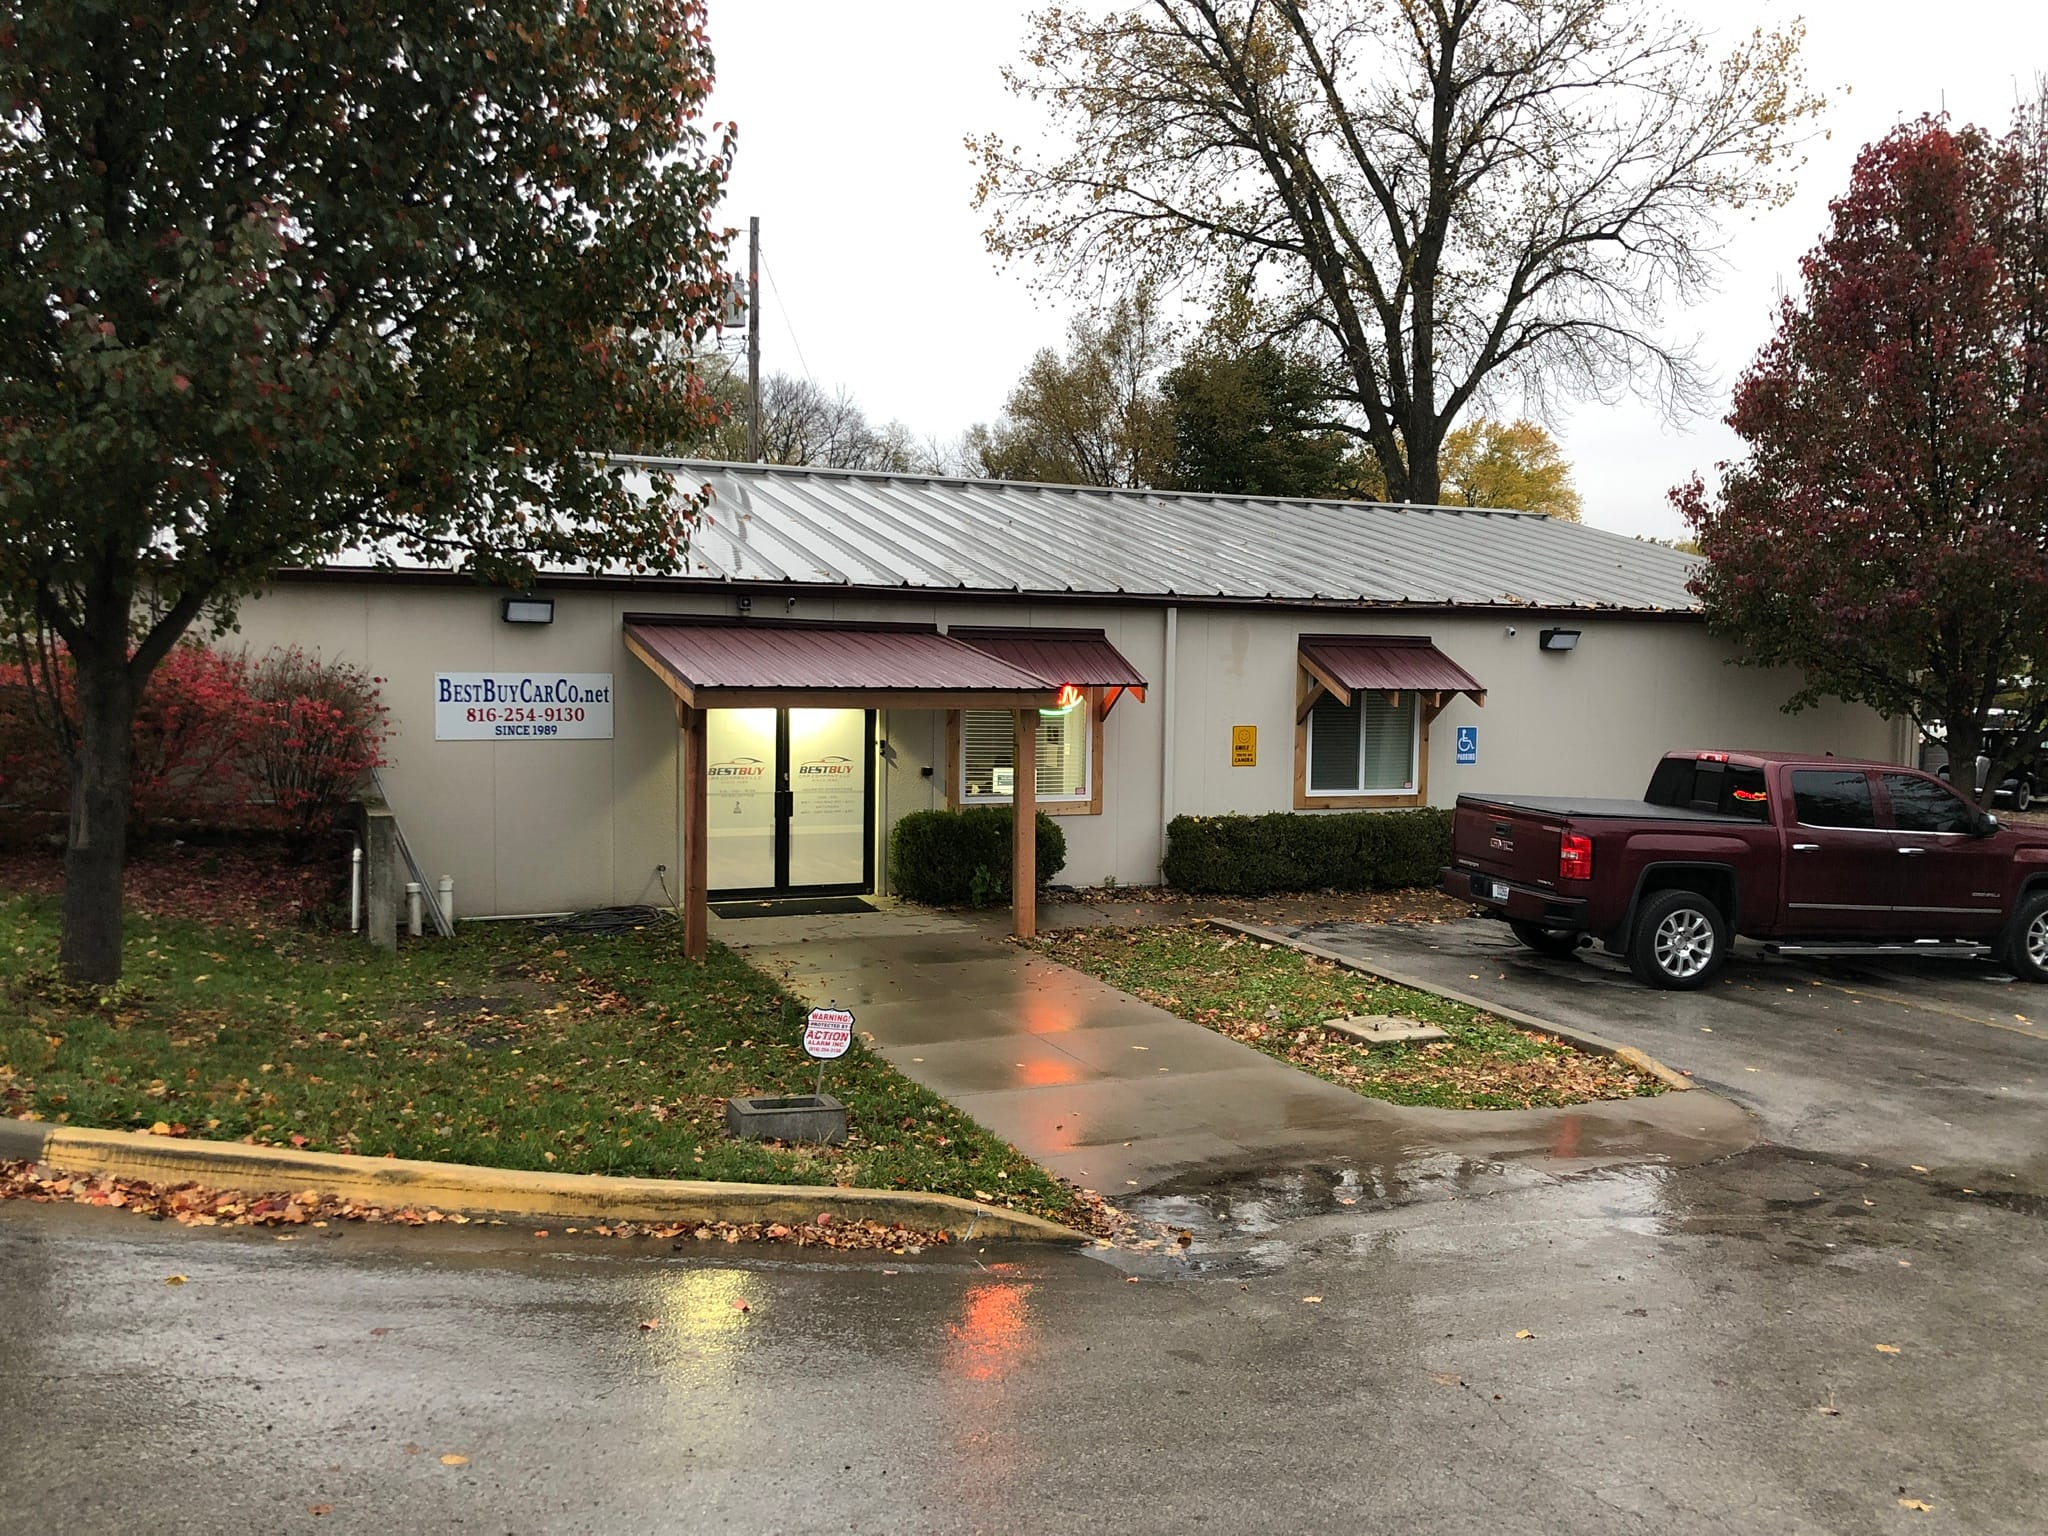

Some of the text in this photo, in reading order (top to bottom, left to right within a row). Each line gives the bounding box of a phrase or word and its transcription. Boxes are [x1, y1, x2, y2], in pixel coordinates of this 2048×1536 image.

[466, 707, 585, 722] 816-254-9130
[495, 725, 558, 736] SINCE 1989
[1490, 837, 1514, 852] GMC
[806, 1030, 849, 1041] ACTION
